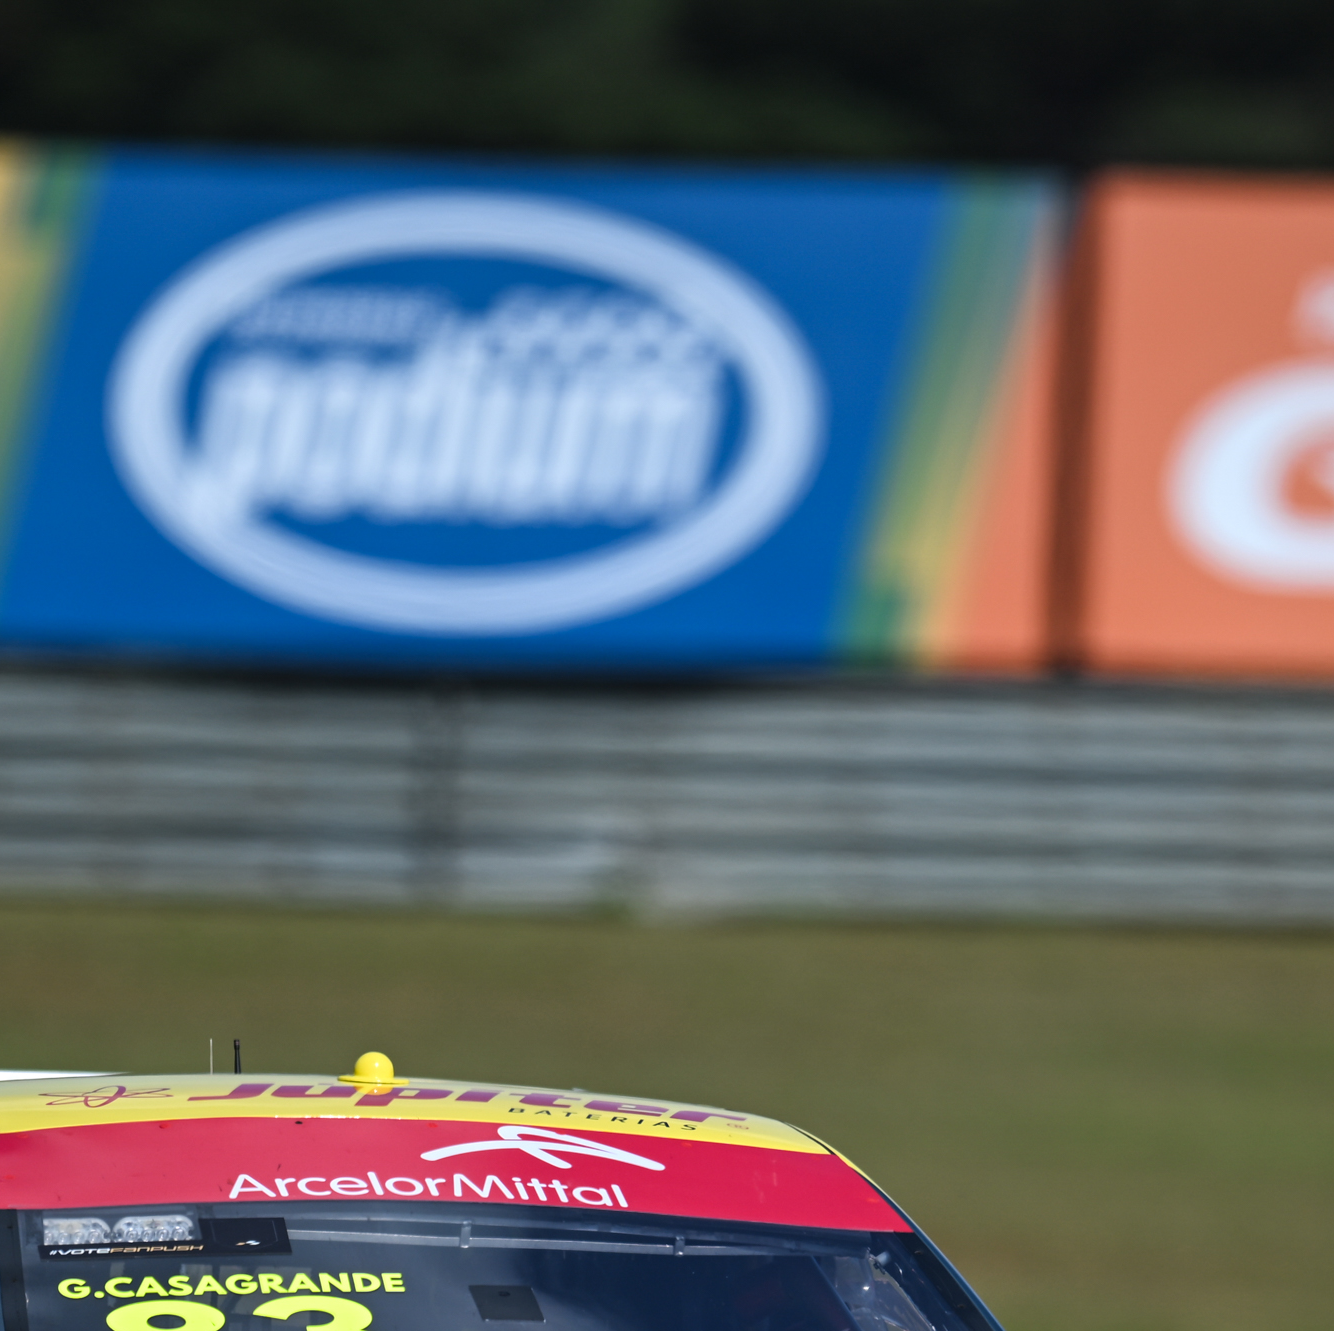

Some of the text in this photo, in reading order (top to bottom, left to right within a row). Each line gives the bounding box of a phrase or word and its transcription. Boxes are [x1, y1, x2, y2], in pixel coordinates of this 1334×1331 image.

[509, 1107, 697, 1131] BATERIAS
[229, 1171, 628, 1208] ArcelorMittal
[58, 1272, 406, 1299] G.CASAGRANDE
